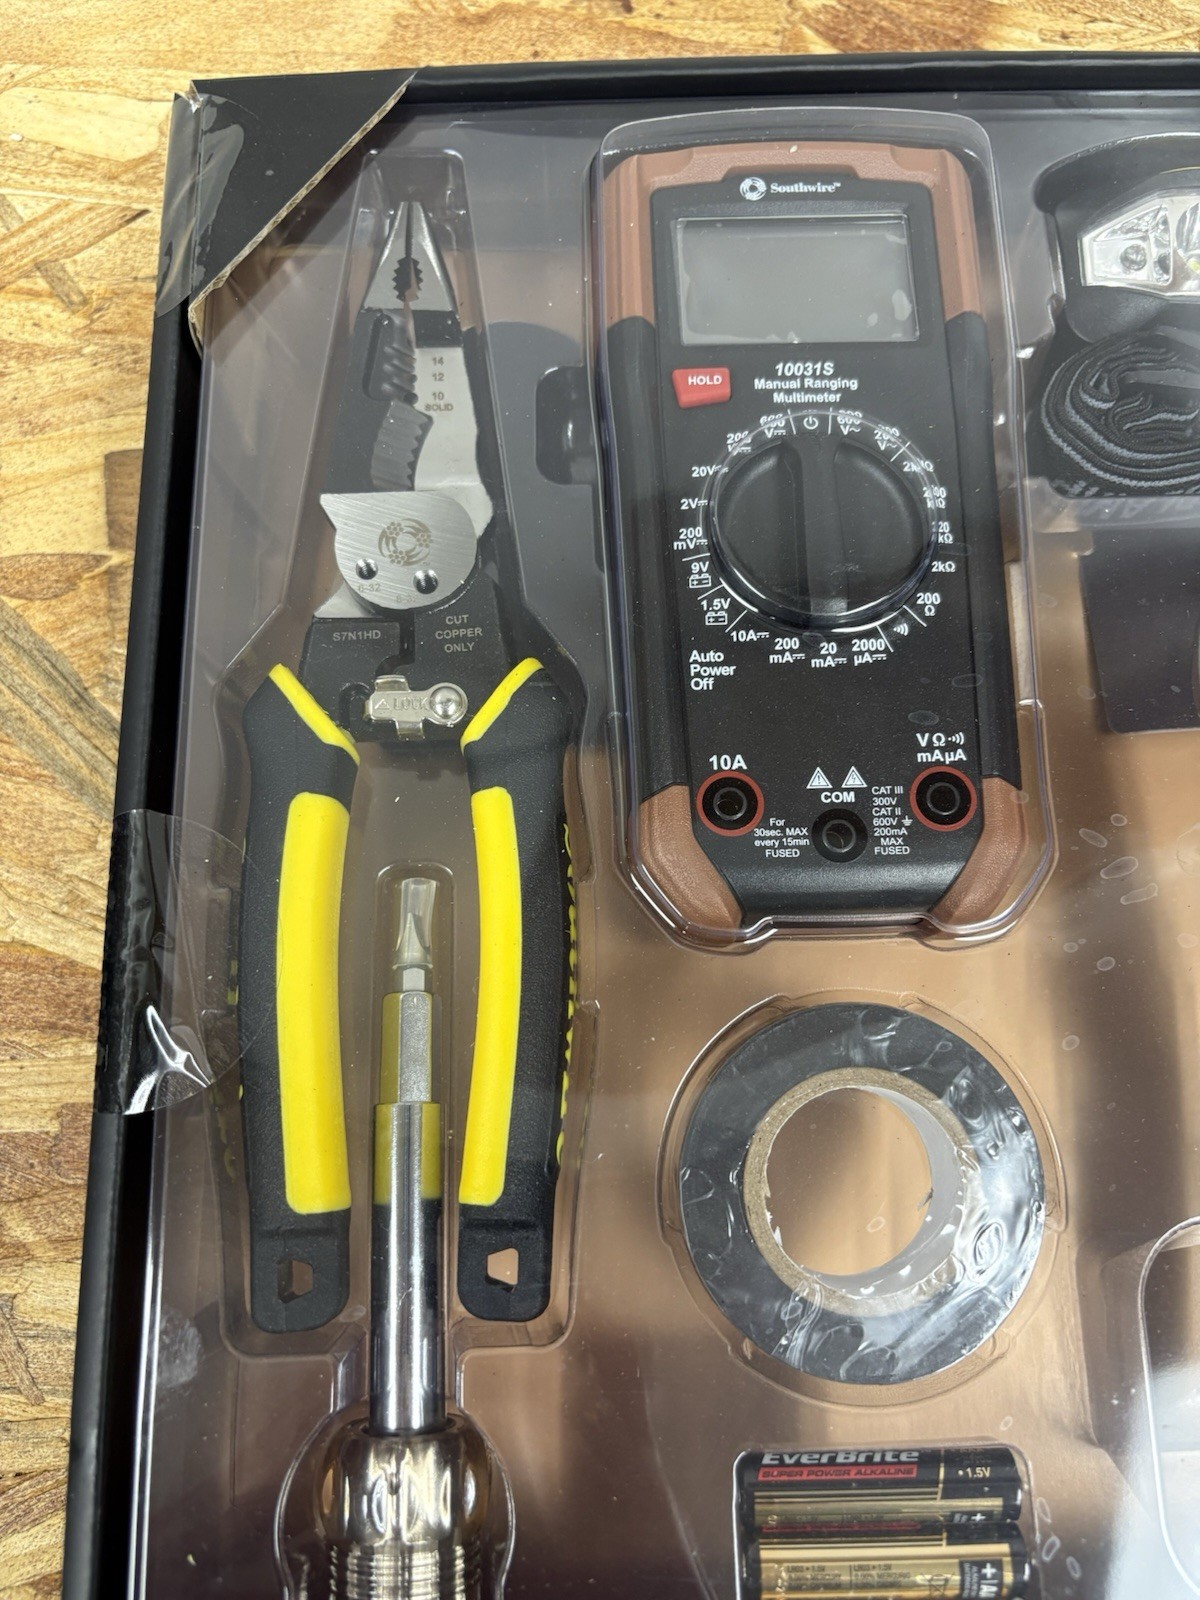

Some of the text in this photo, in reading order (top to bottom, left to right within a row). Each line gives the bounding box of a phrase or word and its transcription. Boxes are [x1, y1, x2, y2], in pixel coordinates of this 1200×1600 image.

[431, 356, 445, 366] 14
[775, 362, 835, 377] 10031S
[431, 372, 445, 382] 12
[687, 374, 723, 386] HOLD
[753, 377, 859, 392] Manual Ranging
[431, 391, 445, 401] 10
[772, 391, 842, 404] Multimeter
[679, 526, 703, 540] 200
[690, 560, 710, 574] 9V
[931, 561, 956, 573] 2kΩ
[700, 597, 731, 611] 1.5V
[916, 592, 941, 605] 200
[445, 614, 470, 625] CUT
[332, 629, 382, 642] S7N1HD
[434, 626, 484, 640] COPPER
[444, 641, 475, 653] ONLY
[774, 637, 800, 651] 200
[819, 641, 838, 655] 20
[851, 638, 886, 652] 2000
[688, 649, 725, 663] Auto
[689, 663, 737, 677] Power
[689, 677, 715, 691] Off
[393, 696, 430, 711] LOCK
[708, 753, 748, 771] 10A
[871, 785, 904, 795] CAT III
[820, 791, 856, 803] COM
[872, 797, 897, 806] 300V
[871, 807, 902, 816] CAT II
[769, 817, 786, 827] For
[872, 817, 898, 826] 600V
[753, 827, 809, 838] 30sec. MAX
[873, 827, 908, 836] 200mA
[753, 837, 810, 849] every 15min
[880, 837, 904, 846] MAX
[765, 848, 801, 858] FUSED
[874, 846, 910, 856] FUSED
[761, 1467, 914, 1479] SUPER POWER ALKALINE
[965, 1466, 991, 1479] 1.5V
